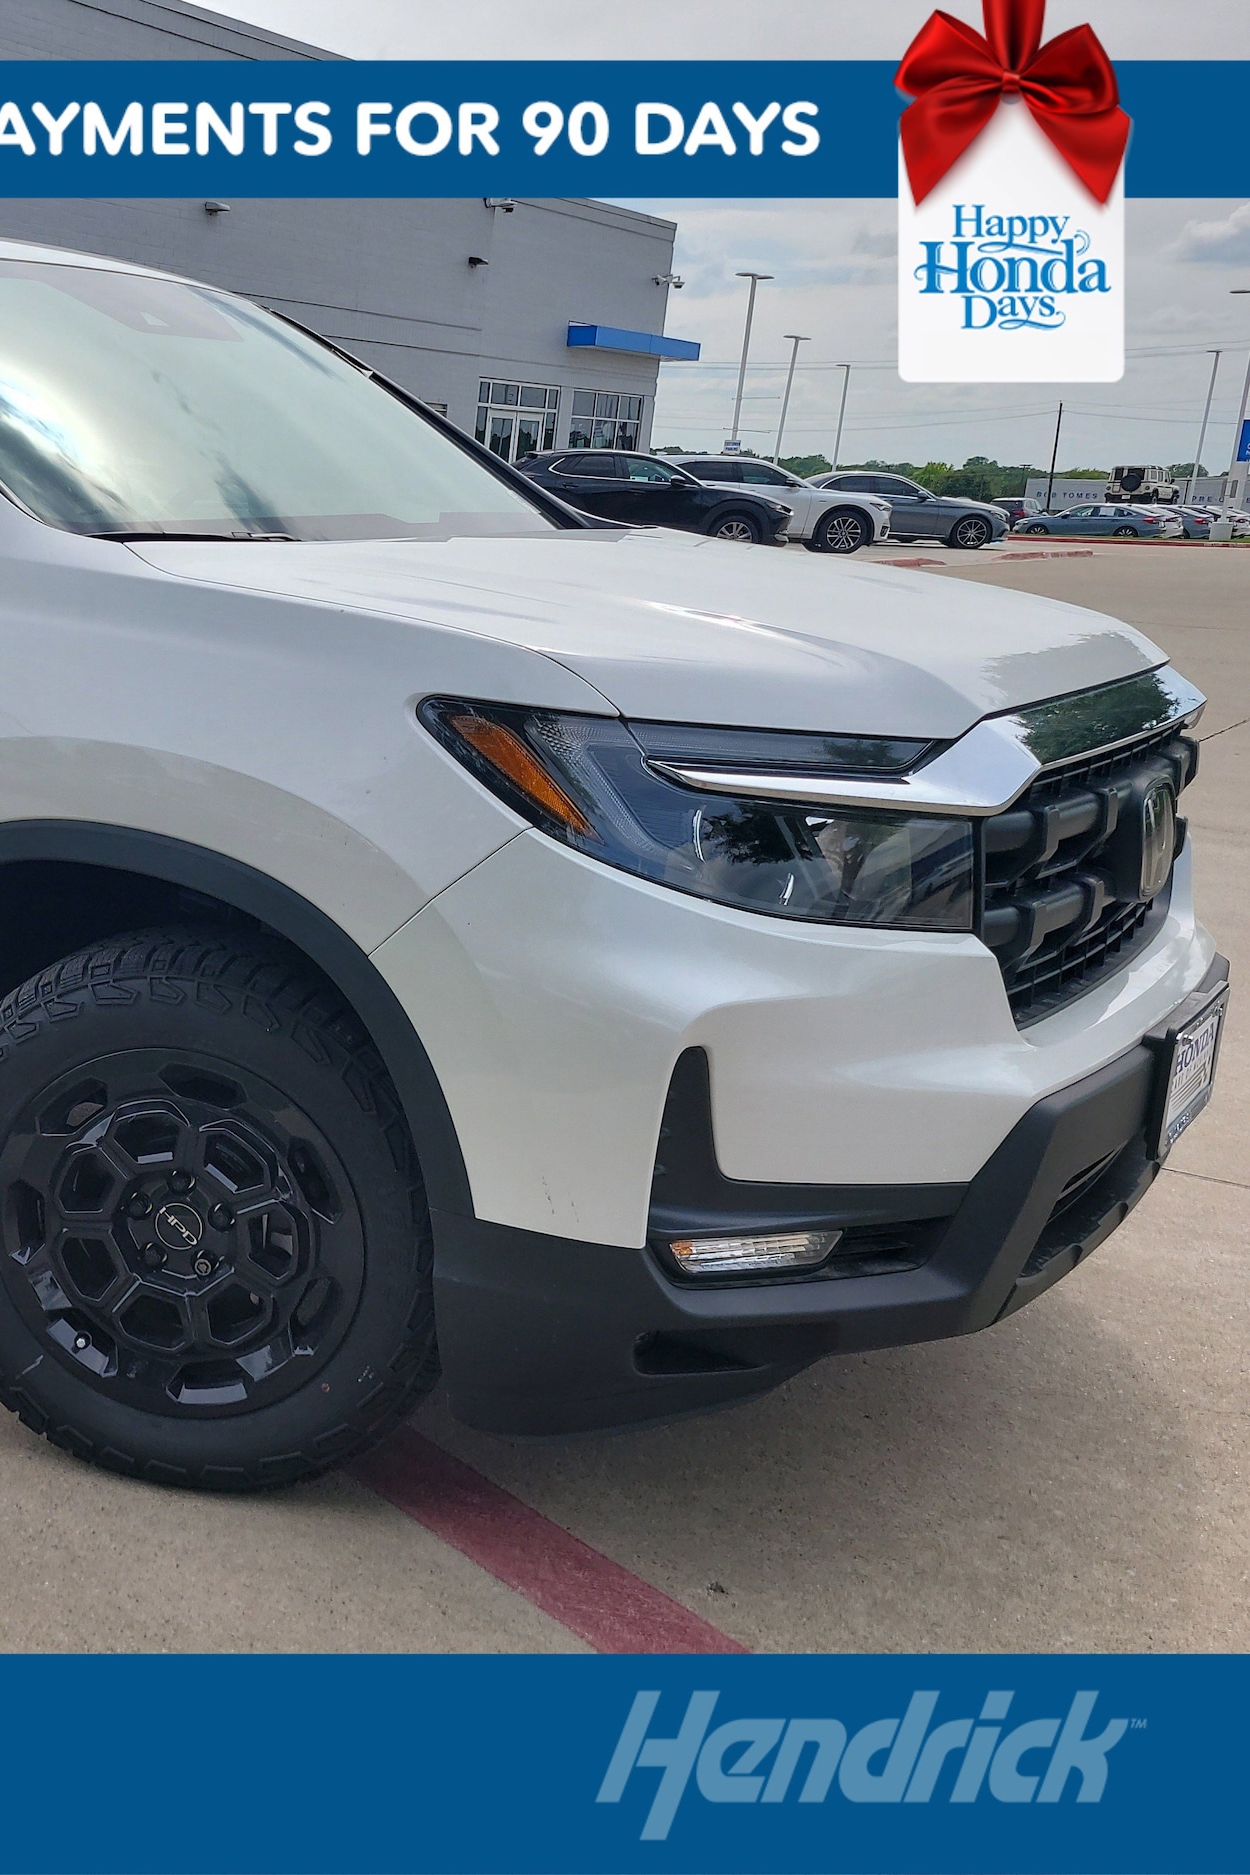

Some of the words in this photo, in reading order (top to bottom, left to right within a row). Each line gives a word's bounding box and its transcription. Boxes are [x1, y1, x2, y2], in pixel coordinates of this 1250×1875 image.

[1063, 491, 1098, 500] TOMES
[1175, 1022, 1214, 1076] HONDA
[159, 1206, 198, 1246] HPD
